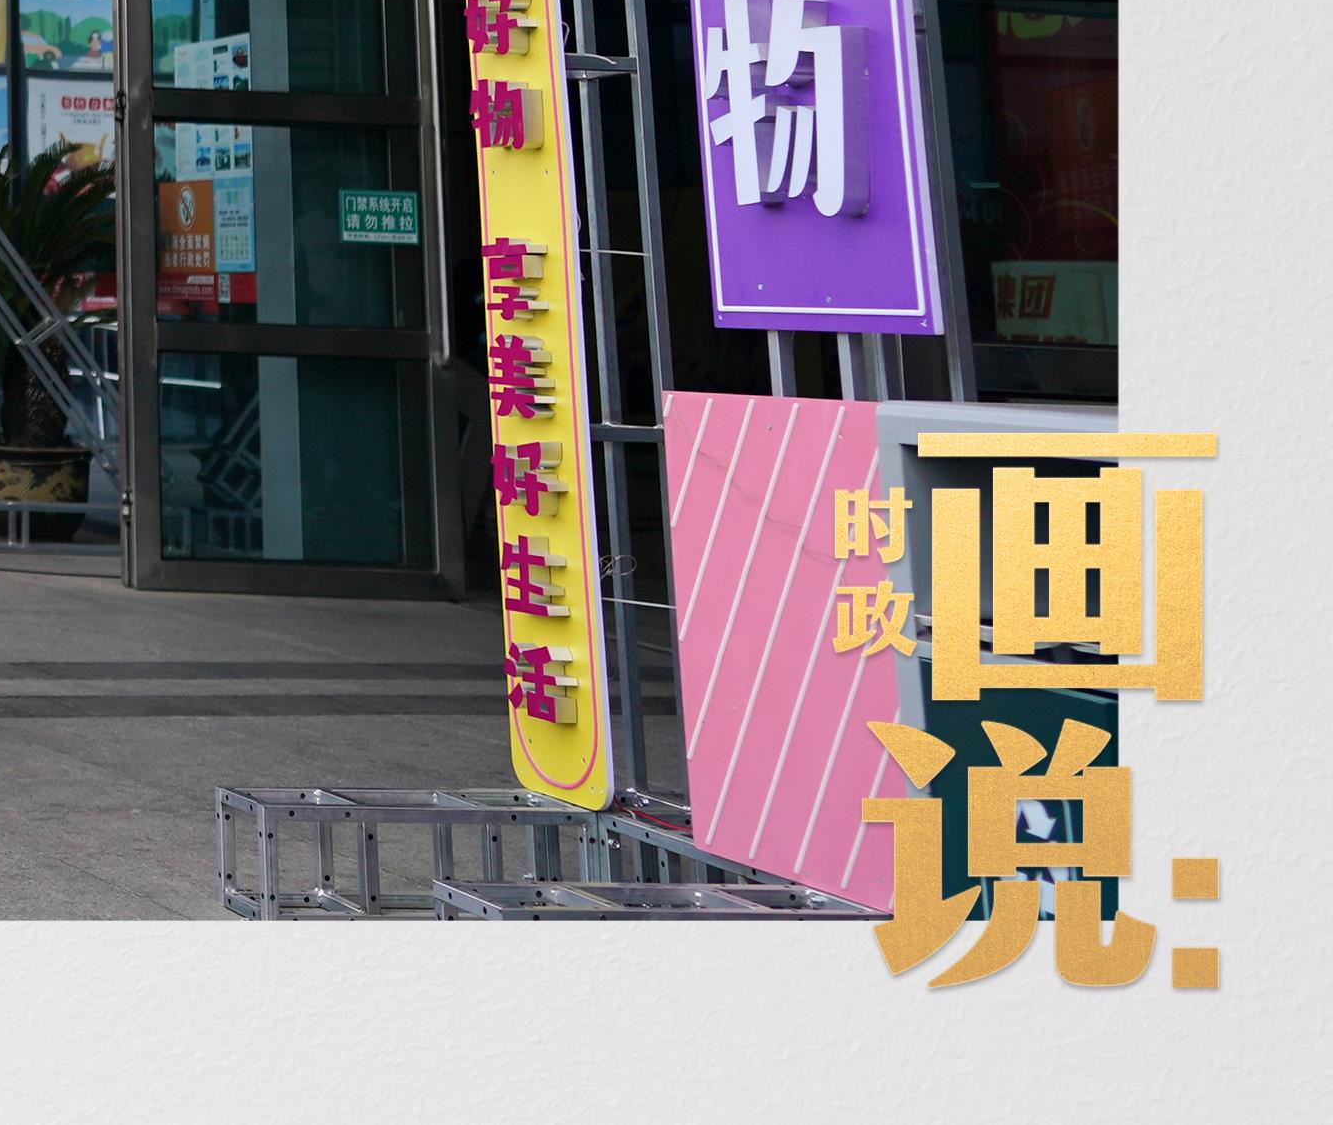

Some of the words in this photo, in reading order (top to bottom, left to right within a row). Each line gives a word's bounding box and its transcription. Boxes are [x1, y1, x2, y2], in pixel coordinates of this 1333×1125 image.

[481, 236, 568, 725] 享美好生活
